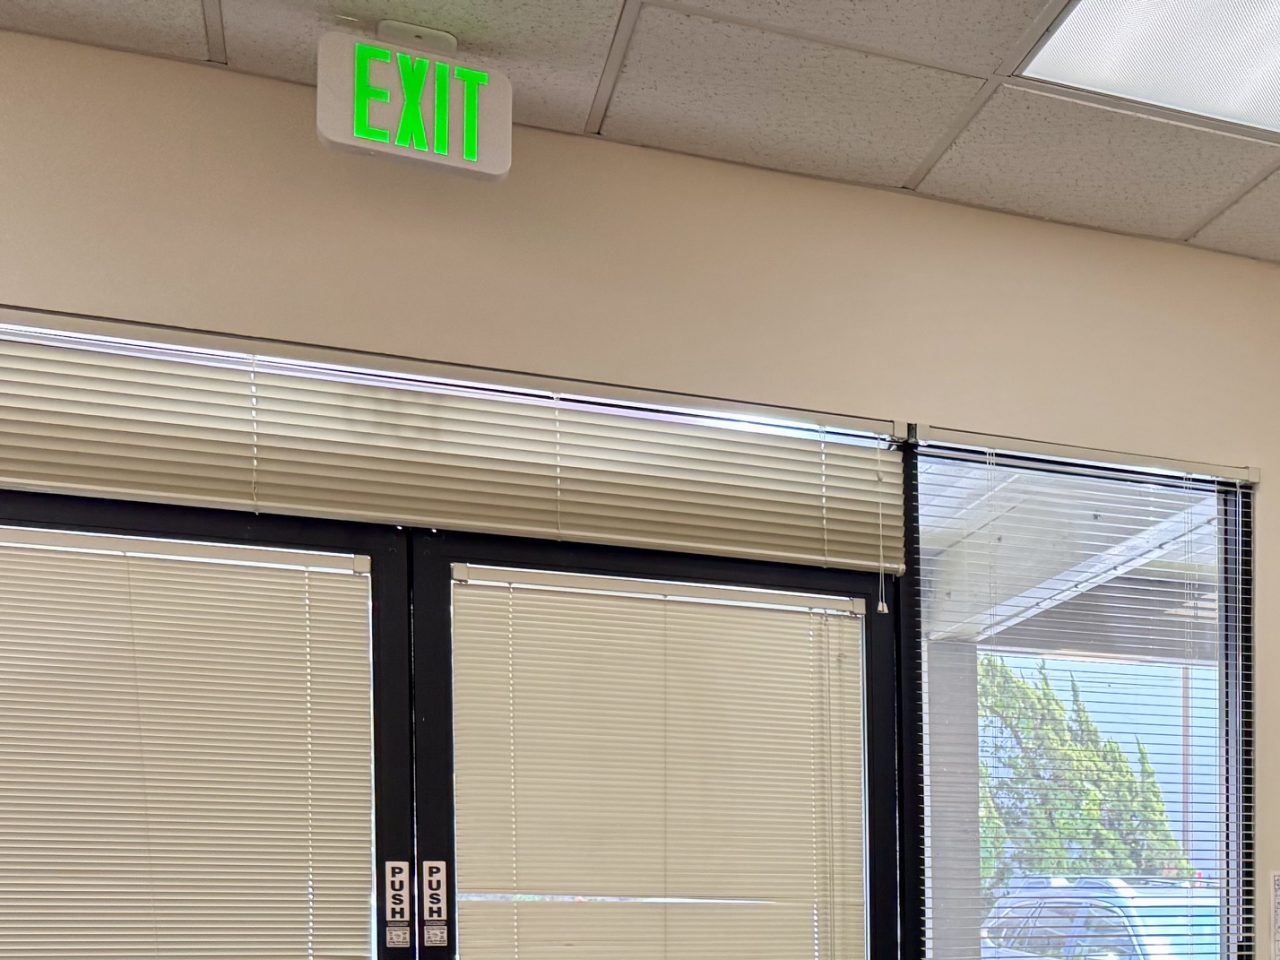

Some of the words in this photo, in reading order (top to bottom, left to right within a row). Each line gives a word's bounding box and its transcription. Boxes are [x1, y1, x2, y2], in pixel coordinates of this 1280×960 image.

[354, 42, 489, 162] EXIT
[390, 866, 404, 919] PUSH
[428, 866, 442, 918] PUSH
